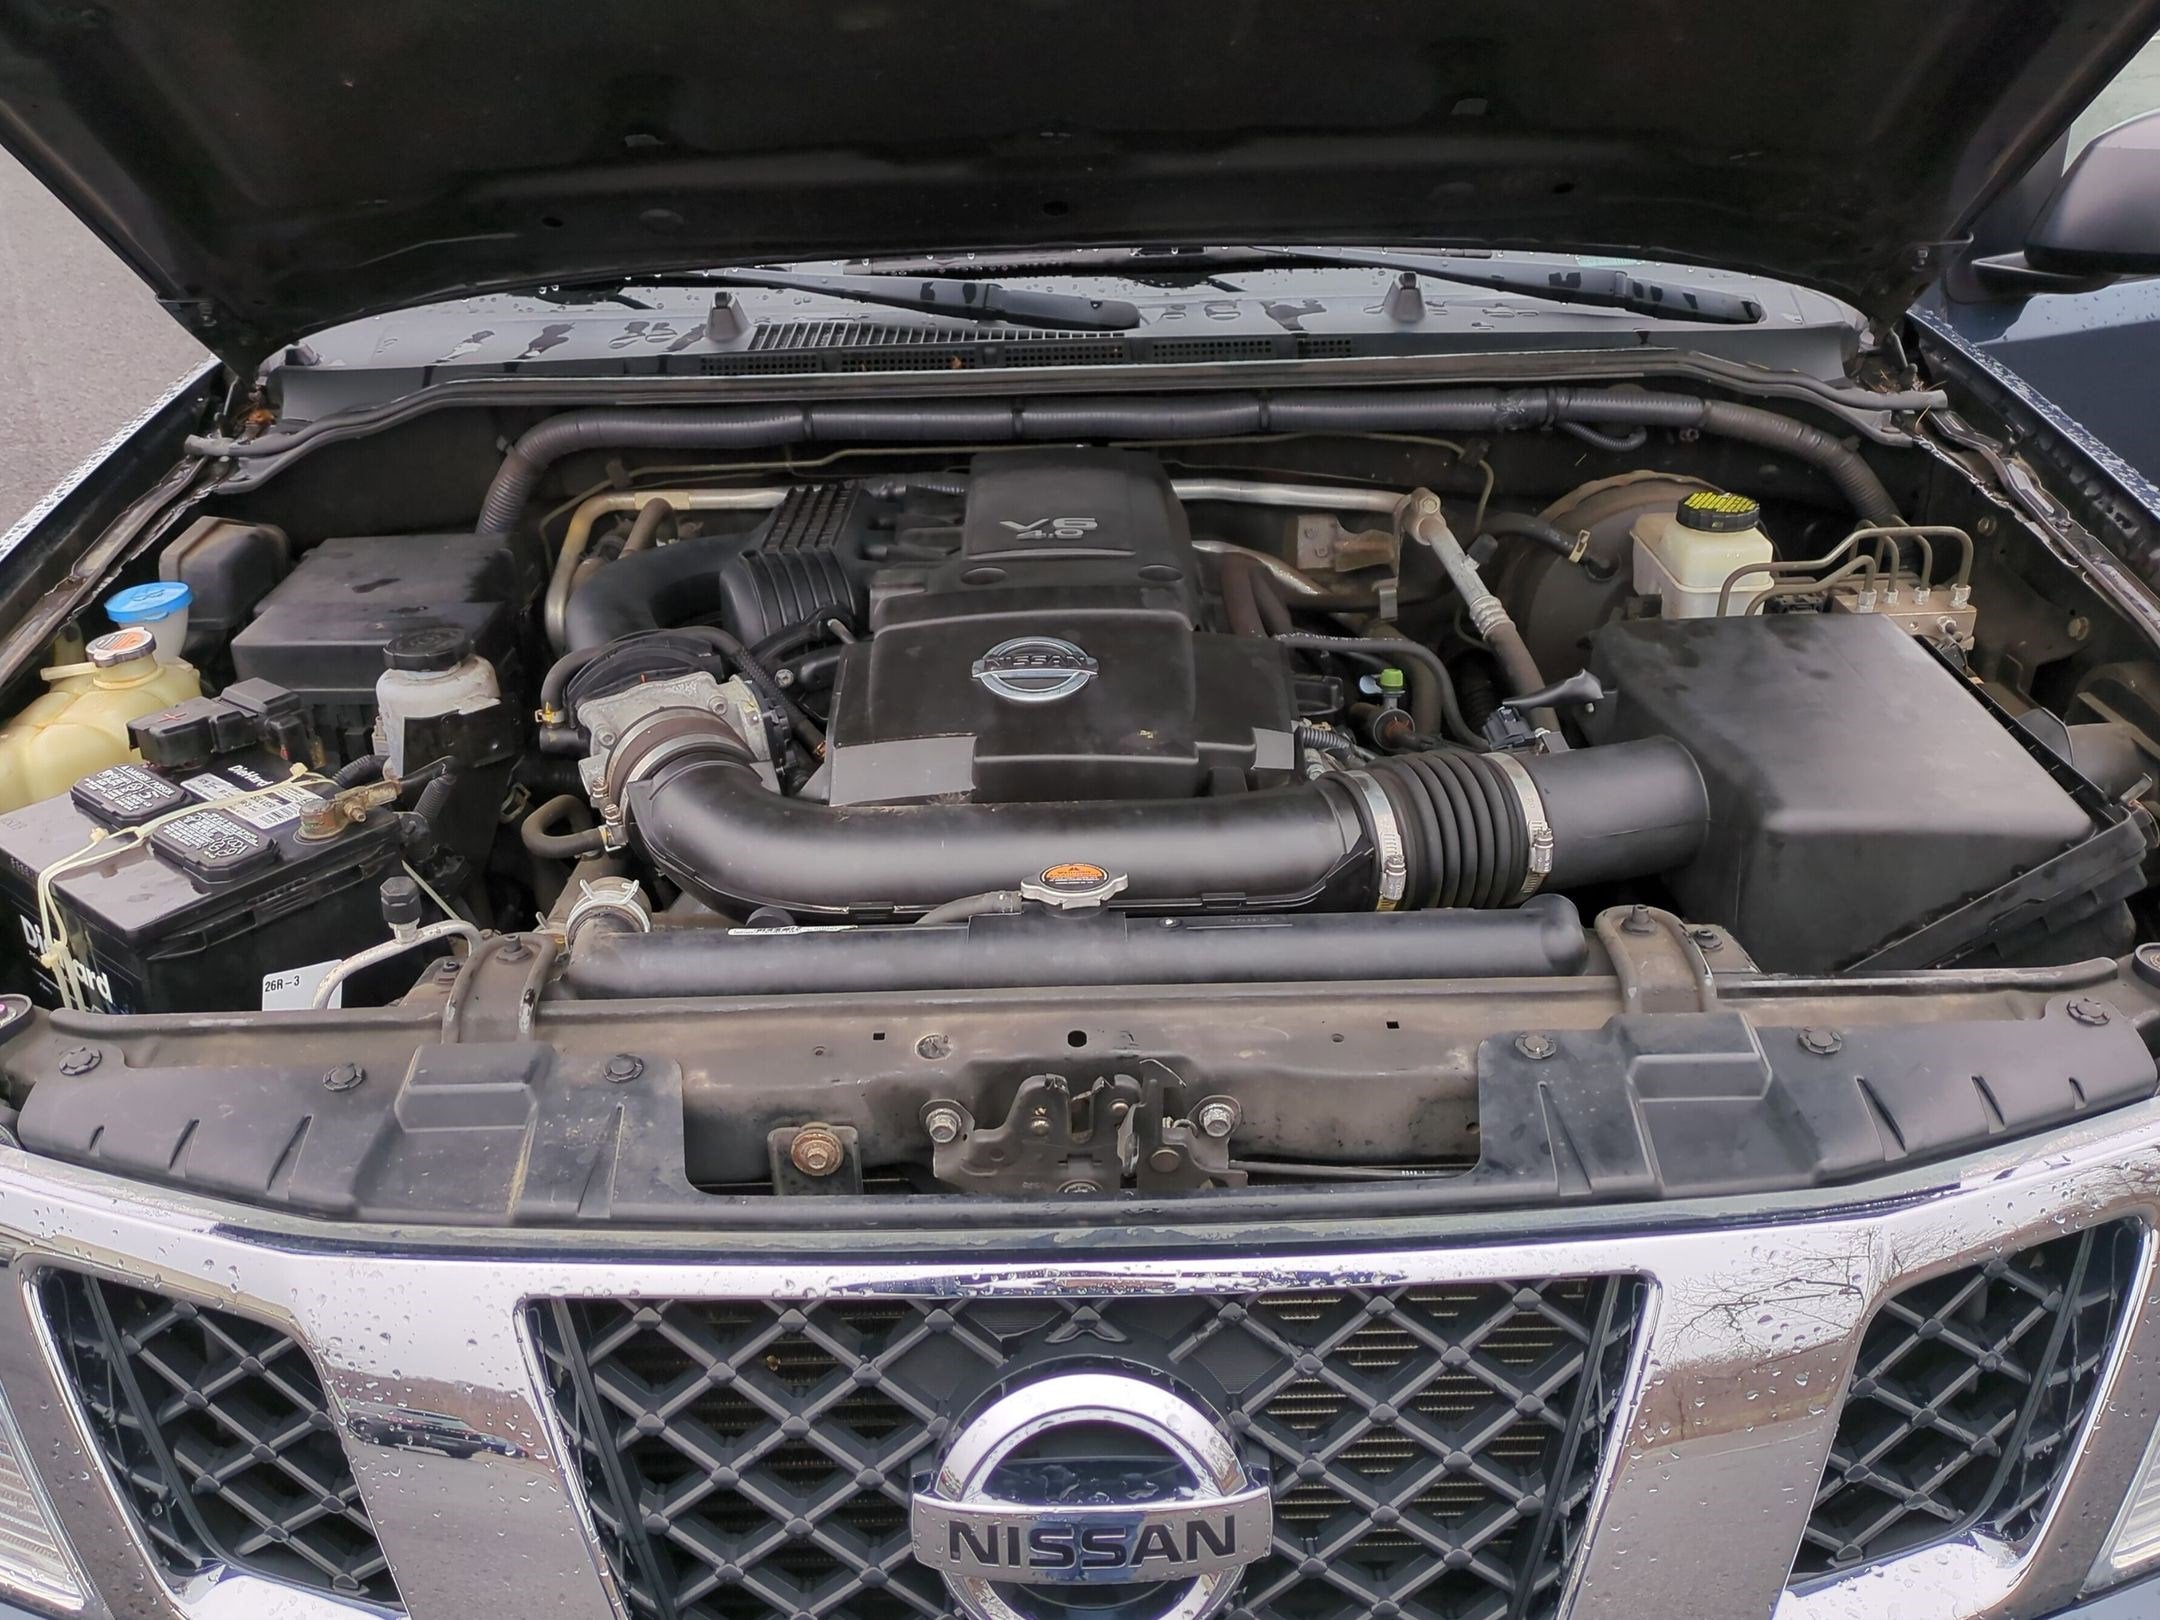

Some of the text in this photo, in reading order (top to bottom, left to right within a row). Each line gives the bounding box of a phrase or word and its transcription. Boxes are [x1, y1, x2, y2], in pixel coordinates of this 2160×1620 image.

[1000, 517, 1098, 531] V6
[1016, 528, 1085, 540] 4.0
[985, 655, 1086, 669] NISSAN
[228, 764, 274, 788] DieHard
[20, 914, 113, 1004] Diard
[948, 1514, 1236, 1569] NISSAN
